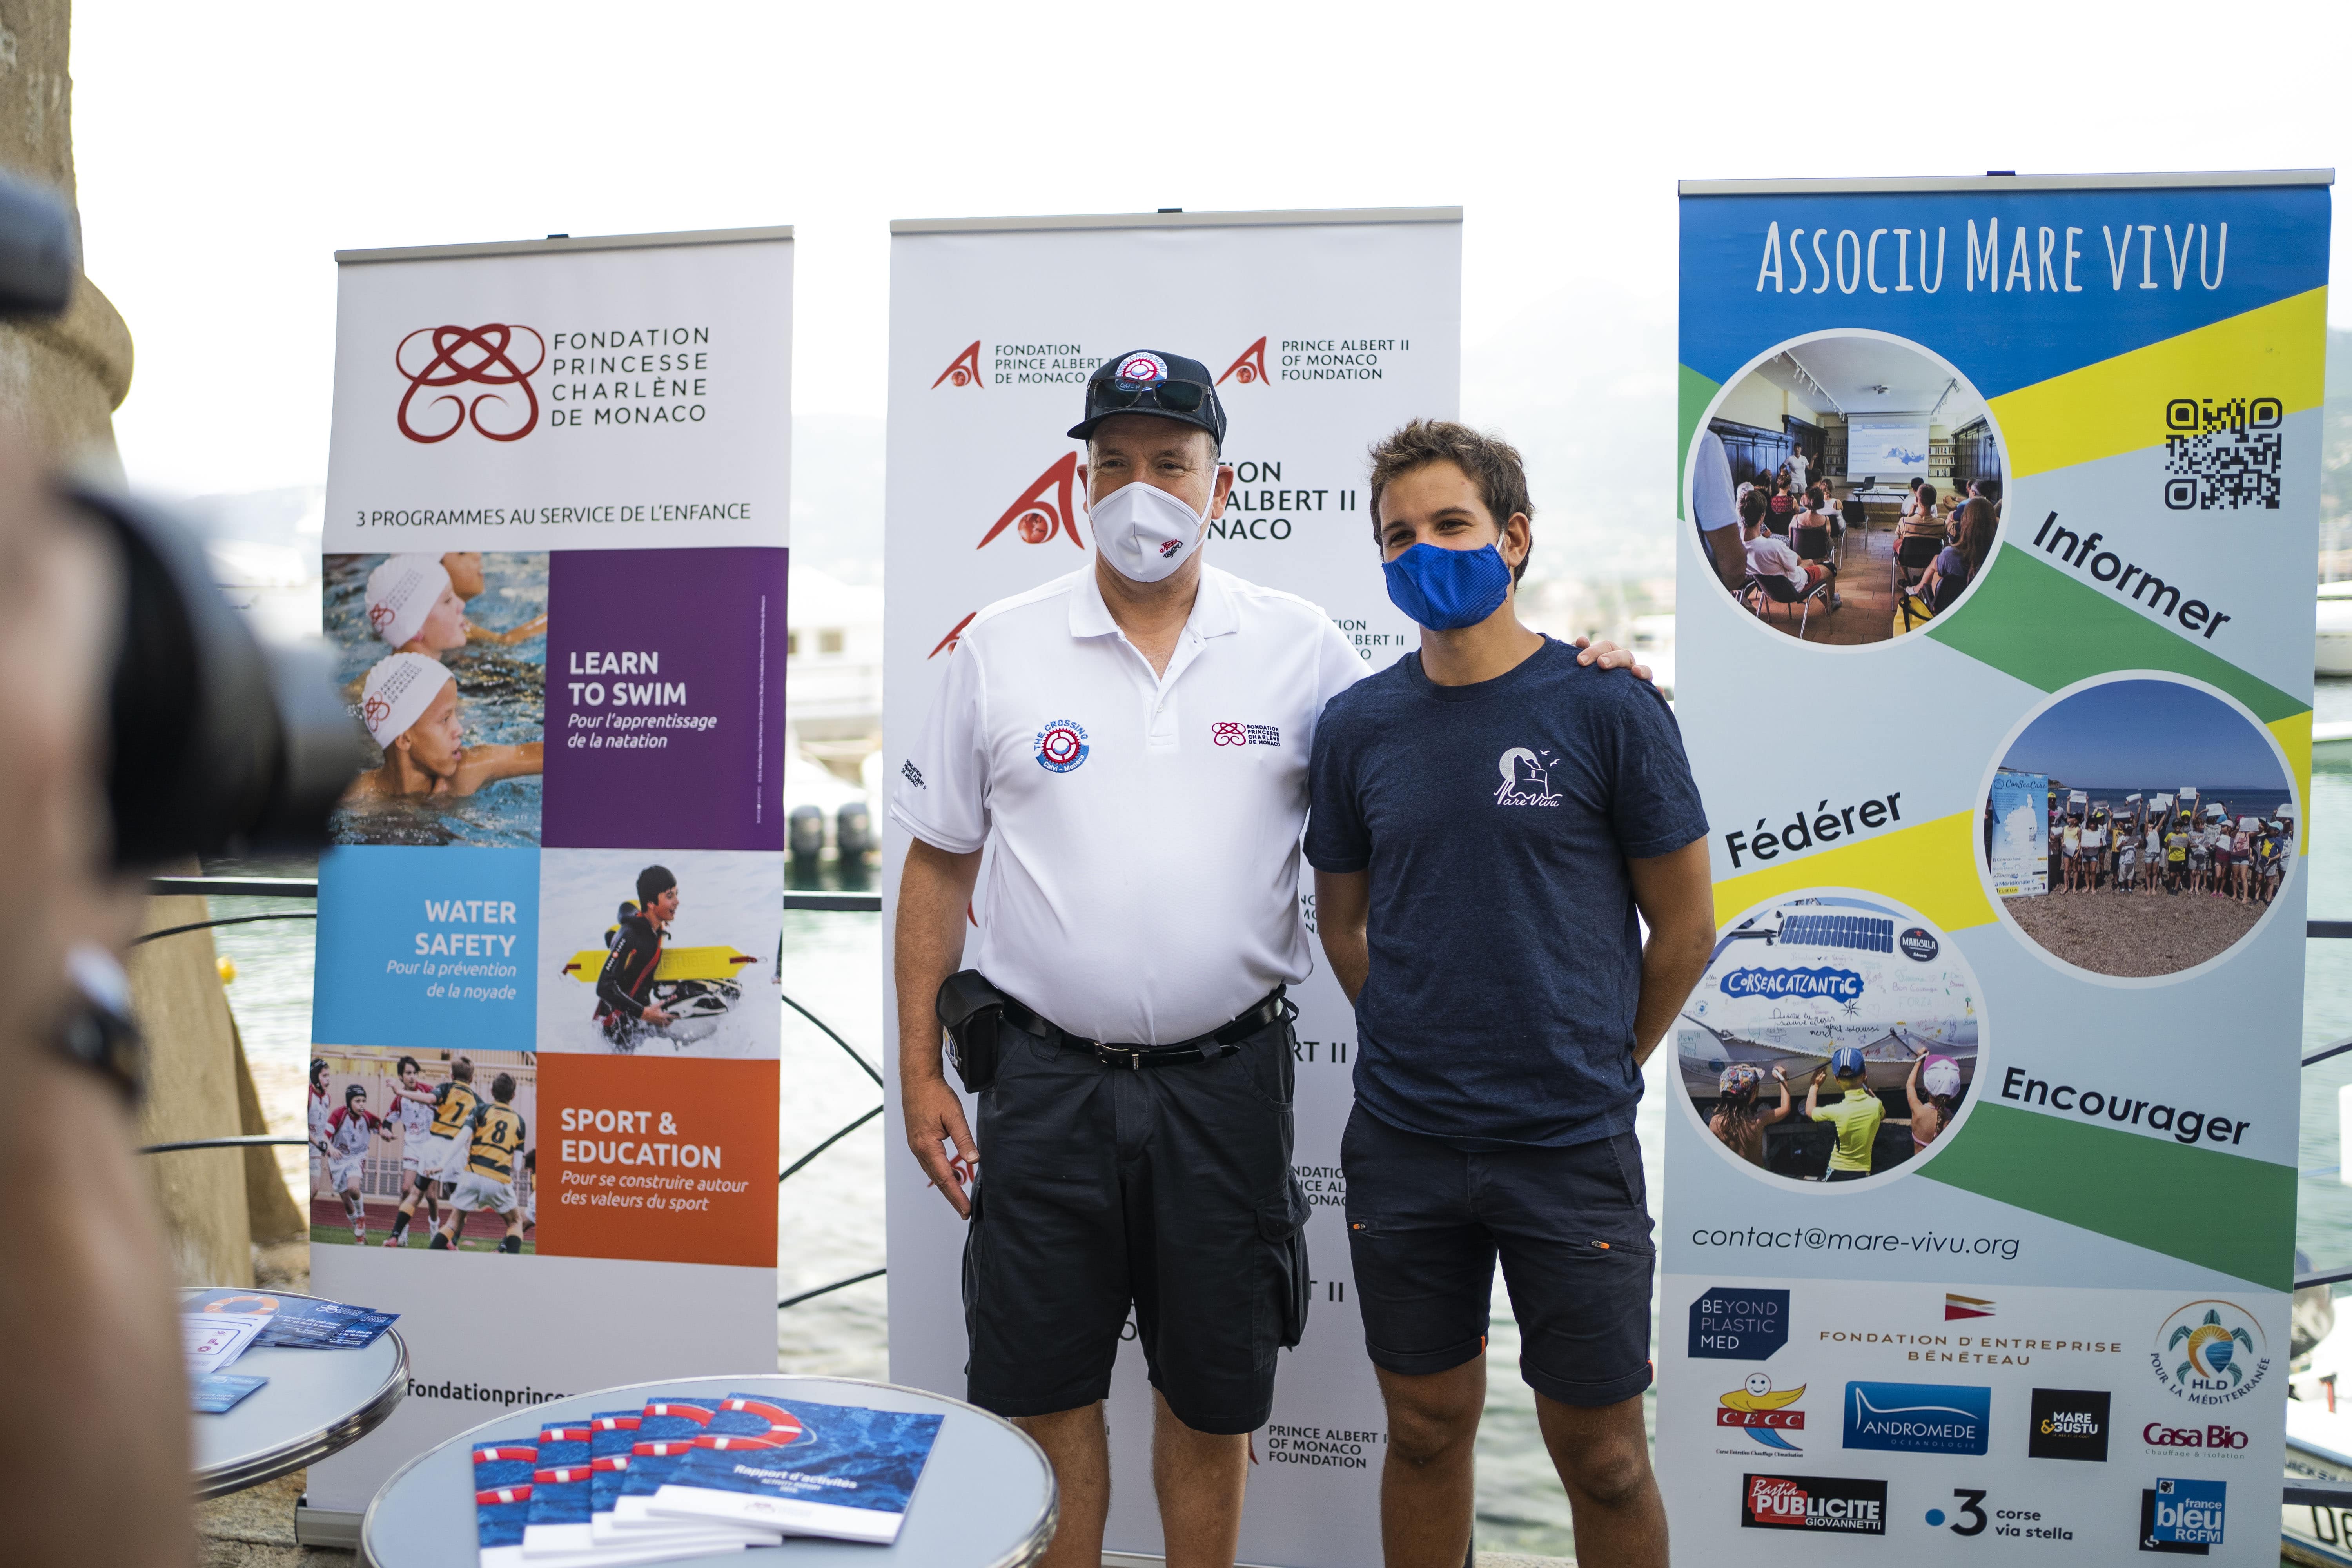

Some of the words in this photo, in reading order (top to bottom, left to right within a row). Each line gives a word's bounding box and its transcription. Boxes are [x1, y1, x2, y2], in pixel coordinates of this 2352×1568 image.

[554, 327, 709, 350] FONDATION
[1283, 340, 1335, 352] PRINCE
[1341, 340, 1395, 351] ALBERT
[1401, 340, 1408, 350] II
[996, 344, 1081, 356] FONDATION
[554, 353, 708, 376] PRINCESSE
[996, 358, 1049, 369] PRINCE
[1052, 358, 1103, 369] ALBERT
[1129, 353, 1167, 372] CROSSING
[1282, 355, 1301, 366] OF
[1307, 354, 1377, 365] MONACO
[996, 373, 1012, 383] DE
[1019, 372, 1085, 383] MONACO
[1282, 369, 1382, 380] FOUNDATION
[553, 376, 706, 401] CHARLÈNE
[552, 408, 582, 426] DE
[595, 404, 706, 425] MONACO
[1225, 490, 1328, 511] ALBERT
[1341, 490, 1355, 511] II
[356, 510, 365, 526] 3
[372, 508, 505, 526] PROGRAMMES
[510, 507, 535, 524] AU
[541, 506, 617, 524] SERVICE
[621, 505, 645, 521] DE
[650, 503, 750, 521] L'ENFANCE
[1208, 519, 1291, 539] NACO
[2032, 510, 2231, 640] Informer
[1396, 635, 1403, 645] II
[569, 652, 659, 675] LEARN
[569, 683, 604, 706] TO
[612, 683, 686, 706] SWIM
[568, 713, 602, 728] Pour
[606, 713, 717, 731] l'apprentissage
[568, 733, 586, 748] de
[590, 733, 602, 748] la
[606, 733, 667, 748] natation
[1034, 732, 1045, 751] THE
[1044, 719, 1088, 740] CROSSING
[1043, 761, 1058, 771] Calvi
[1064, 755, 1085, 772] Monaco
[1530, 793, 1560, 807] Vivu
[1726, 791, 1902, 868] Fédérer
[425, 900, 516, 924] WATER
[415, 933, 516, 957] SAFETY
[386, 960, 421, 975] Pour
[423, 960, 436, 975] la
[439, 961, 517, 980] prévention
[427, 983, 445, 998] de
[448, 983, 460, 998] la
[463, 984, 516, 1001] noyade
[1332, 1042, 1346, 1063] II
[2001, 1066, 2251, 1144] Encourager
[561, 1108, 652, 1134] SPORT
[659, 1112, 677, 1135] &
[492, 1120, 508, 1143] 8
[562, 1140, 721, 1169] EDUCATION
[561, 1170, 597, 1187] Pour
[600, 1174, 615, 1187] se
[619, 1173, 694, 1191] construire
[698, 1179, 749, 1193] autour
[561, 1190, 587, 1205] des
[590, 1191, 644, 1209] valeurs
[647, 1194, 664, 1210] du
[667, 1197, 709, 1212] sport
[1692, 1226, 2020, 1260] contact@mare-vivu.org
[1329, 1281, 1343, 1302] II
[1702, 1299, 1778, 1316] BEYOND
[1702, 1318, 1775, 1333] PLASTIC
[1701, 1335, 1739, 1350] MED
[1820, 1331, 1947, 1346] FONDATION
[2150, 1352, 2169, 1384] POUR
[2169, 1384, 2183, 1398] LA
[2188, 1357, 2270, 1405] MÉDITERRANÉE
[2192, 1379, 2228, 1390] HLD
[2053, 1411, 2091, 1423] MARE
[1269, 1425, 1320, 1439] PRINCE
[1326, 1430, 1378, 1443] ALBERT
[1864, 1421, 1975, 1439] ANDROMEDE
[2143, 1423, 2203, 1447] Casa
[2207, 1425, 2249, 1449] Bio
[1269, 1438, 1289, 1449] OF
[1294, 1440, 1361, 1455] MONACO
[2145, 1448, 2190, 1458] Chauffage
[1269, 1451, 1367, 1468] FOUNDATION
[733, 1464, 789, 1480] Rapport
[1751, 1479, 1799, 1498] Bastia
[1756, 1495, 1879, 1520] PUBLICITE
[1950, 1488, 1988, 1536] 3
[1996, 1508, 2042, 1521] corse
[2185, 1498, 2222, 1510] france
[1805, 1518, 1881, 1530] GIOVANNETTI
[2157, 1501, 2222, 1530] bleu
[1995, 1525, 2021, 1537] via
[2026, 1526, 2073, 1541] stella
[2175, 1529, 2221, 1542] RCFM
